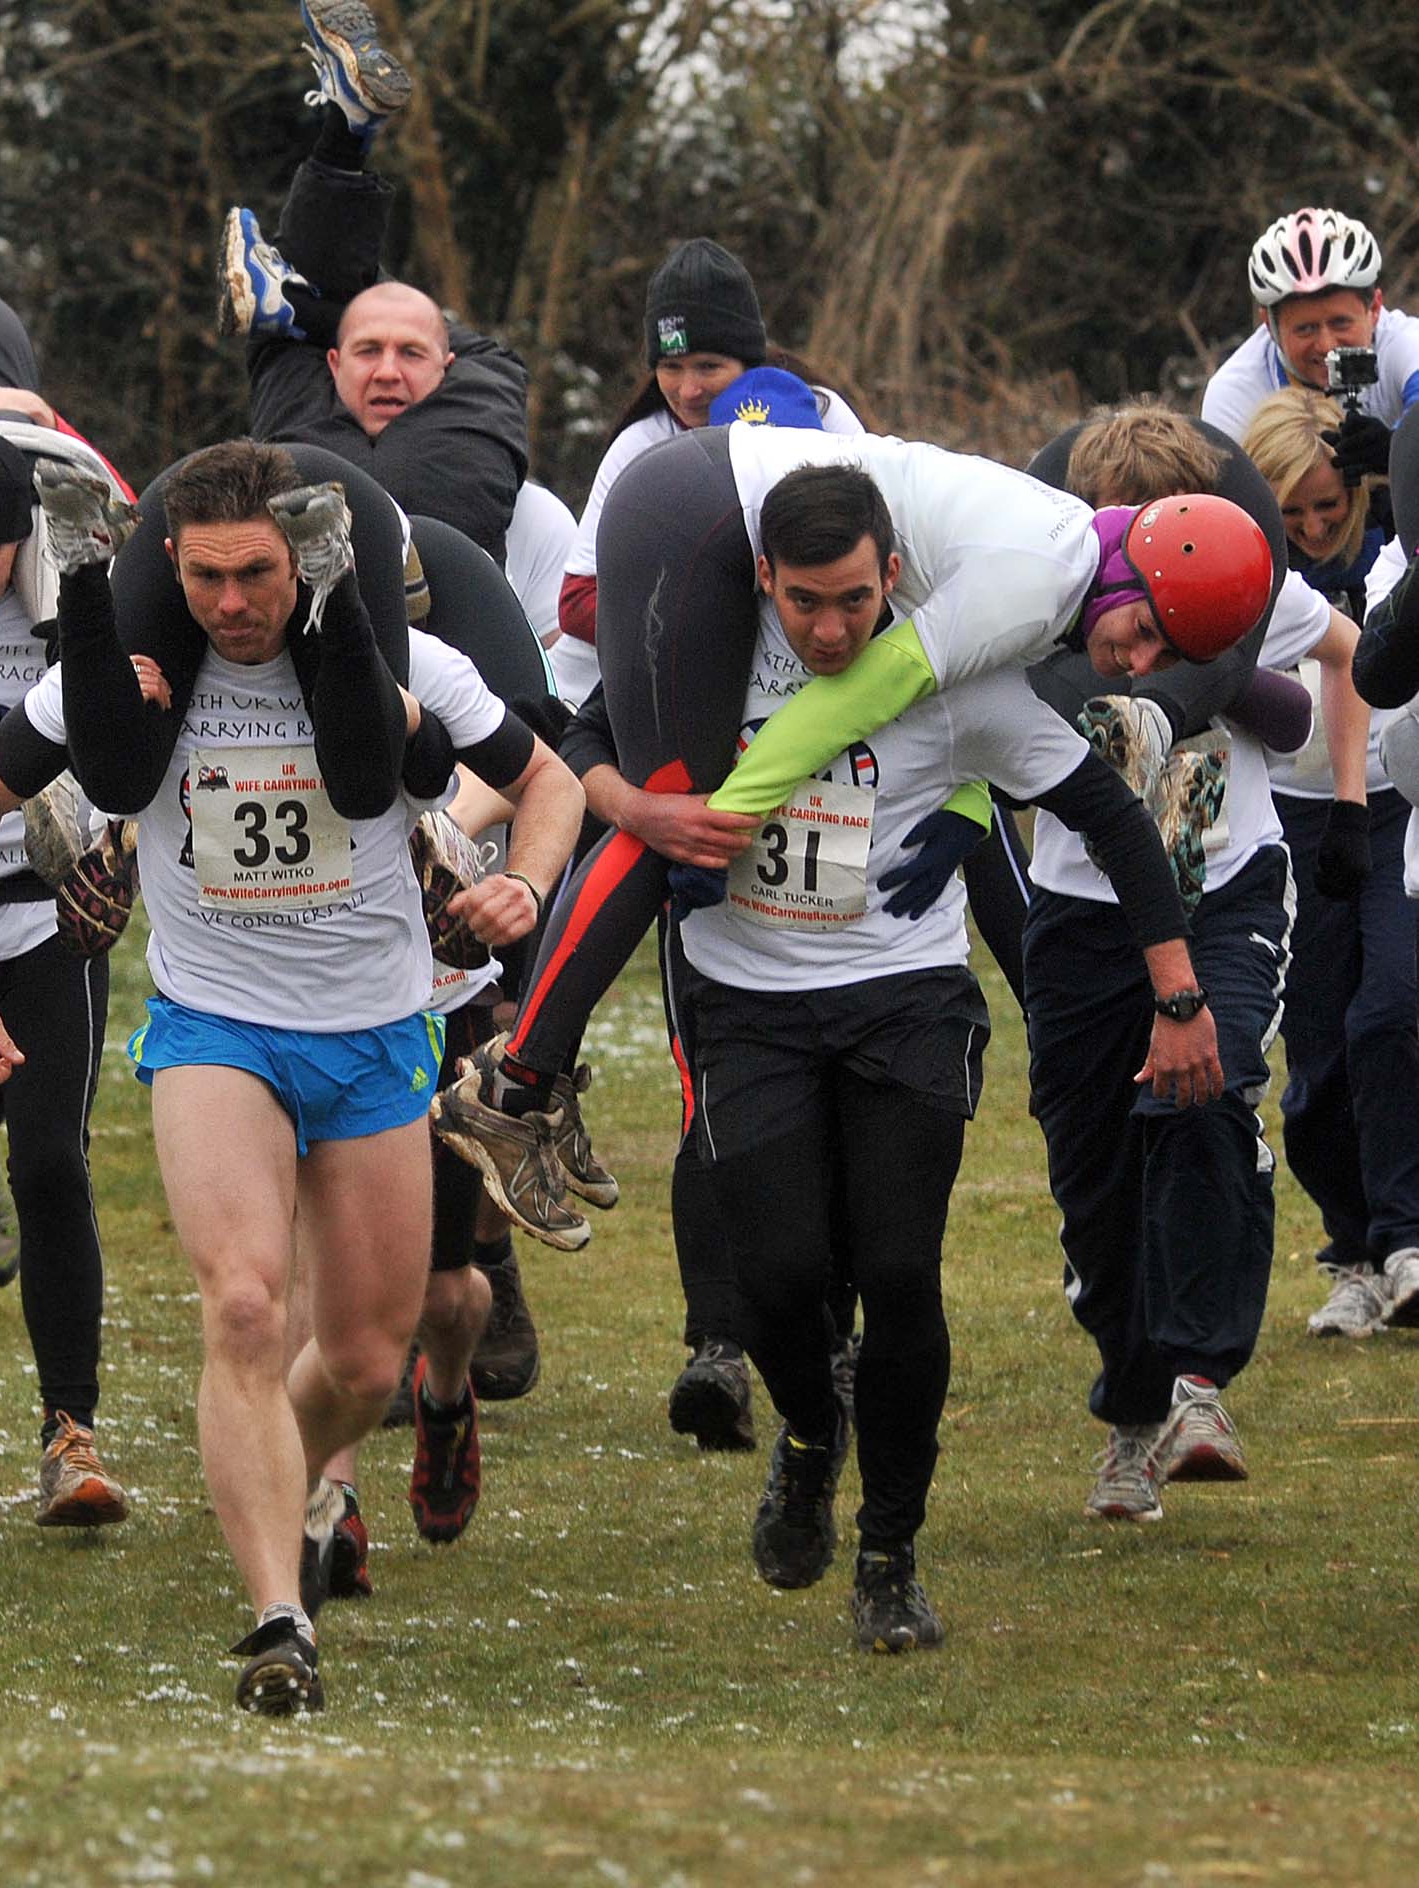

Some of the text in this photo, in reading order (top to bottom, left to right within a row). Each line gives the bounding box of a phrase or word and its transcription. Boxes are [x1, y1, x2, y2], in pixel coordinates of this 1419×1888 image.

[764, 651, 795, 674] 6TH
[232, 696, 272, 710] UK
[182, 720, 286, 739] ARRYING
[282, 763, 296, 775] UK
[235, 779, 260, 792] WIFE
[264, 778, 316, 791] CARRYING
[809, 796, 822, 806] UK
[790, 807, 840, 825] CARRYING
[842, 816, 869, 828] RACE
[233, 800, 311, 867] 33
[757, 823, 821, 892] 31
[234, 866, 314, 882] MATT WITKO
[751, 884, 833, 908] CARL TUCKER
[232, 904, 333, 929] CONQUERS
[339, 893, 366, 913] ALL
